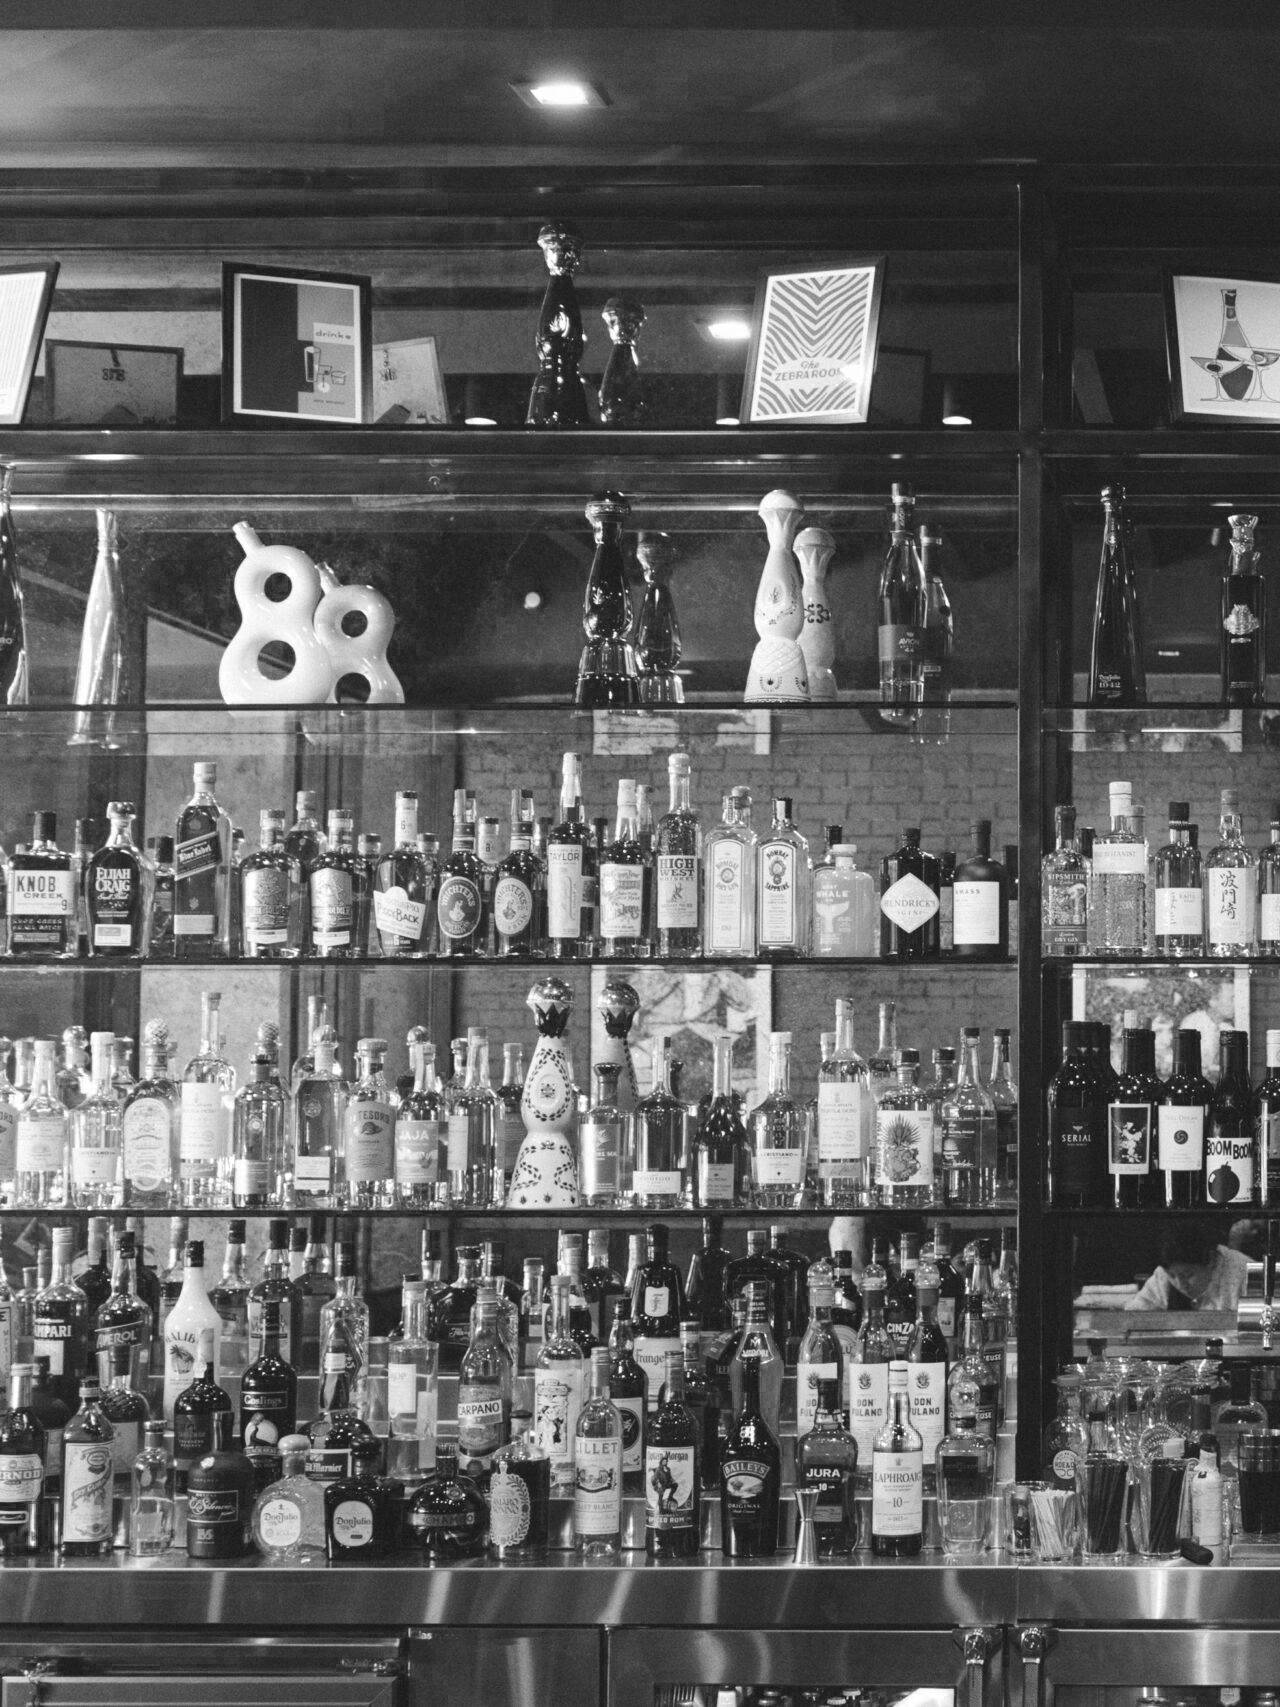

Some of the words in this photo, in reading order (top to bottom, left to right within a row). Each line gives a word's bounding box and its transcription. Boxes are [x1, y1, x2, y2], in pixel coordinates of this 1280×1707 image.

[775, 371, 809, 381] ZEBRA
[766, 849, 789, 860] BOMBAY
[660, 858, 695, 869] HIGH
[96, 868, 131, 880] ELIJAH
[660, 869, 695, 877] WEST
[17, 875, 56, 892] KNOB
[95, 879, 131, 892] CRAIG
[816, 890, 848, 898] WHALE
[61, 899, 67, 911] 9
[1061, 1134, 1091, 1143] SERIAL
[1207, 1140, 1232, 1156] BOOM
[97, 1329, 137, 1347] APEROL
[857, 1398, 875, 1407] DON
[914, 1397, 932, 1406] DON
[458, 1402, 500, 1418] CARPANO
[911, 1407, 940, 1416] ULANO
[579, 1442, 618, 1454] ILLET
[665, 1451, 689, 1462] Morgan
[724, 1462, 768, 1475] BAILEYS
[806, 1468, 841, 1478] JURA
[873, 1472, 922, 1483] LAPHROAIG
[818, 1483, 828, 1491] 10
[892, 1497, 903, 1508] 10
